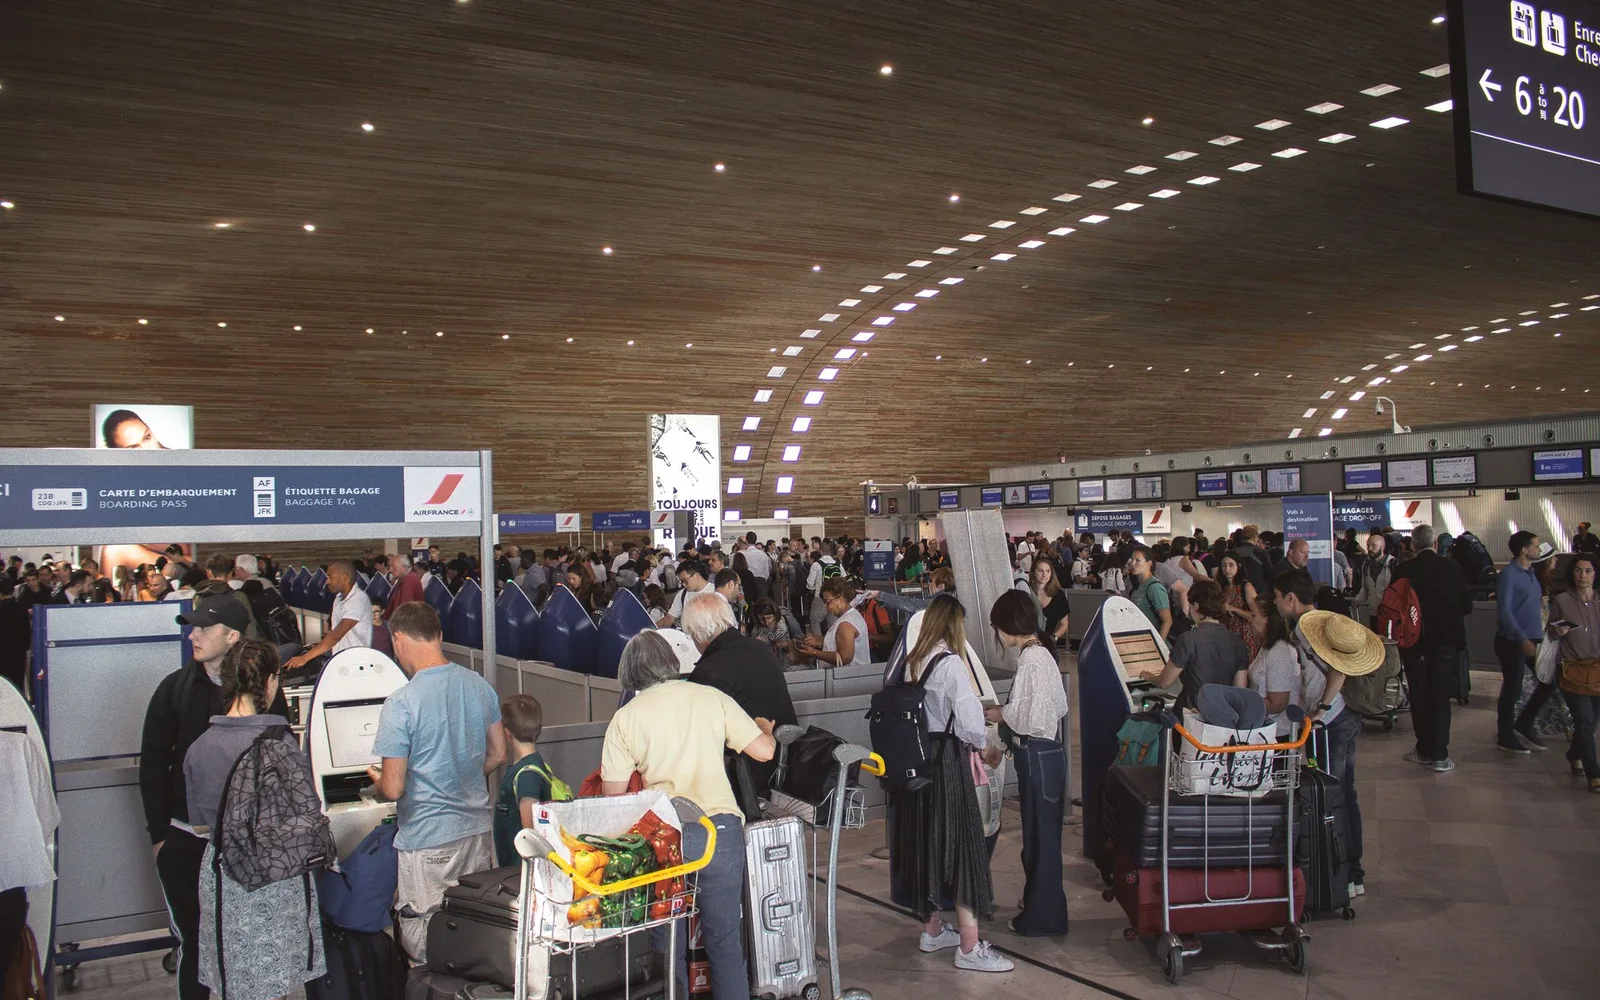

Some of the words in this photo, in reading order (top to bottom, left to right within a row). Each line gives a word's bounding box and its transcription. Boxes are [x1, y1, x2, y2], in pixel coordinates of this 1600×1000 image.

[1575, 44, 1600, 67] Che
[1515, 76, 1532, 116] 6
[1553, 86, 1584, 130] 20
[1538, 95, 1547, 108] to
[99, 489, 135, 497] CARTE
[285, 486, 337, 496] ÉTIQUETTE
[339, 487, 381, 496] BAGAGE
[100, 500, 157, 509] BOARDING
[161, 499, 188, 508] PASS
[285, 498, 334, 506] BAGGAGE
[337, 498, 356, 506] TAG
[656, 499, 718, 510] TOUJOURS
[870, 499, 877, 511] 4
[1348, 514, 1383, 522] DROP-OFF
